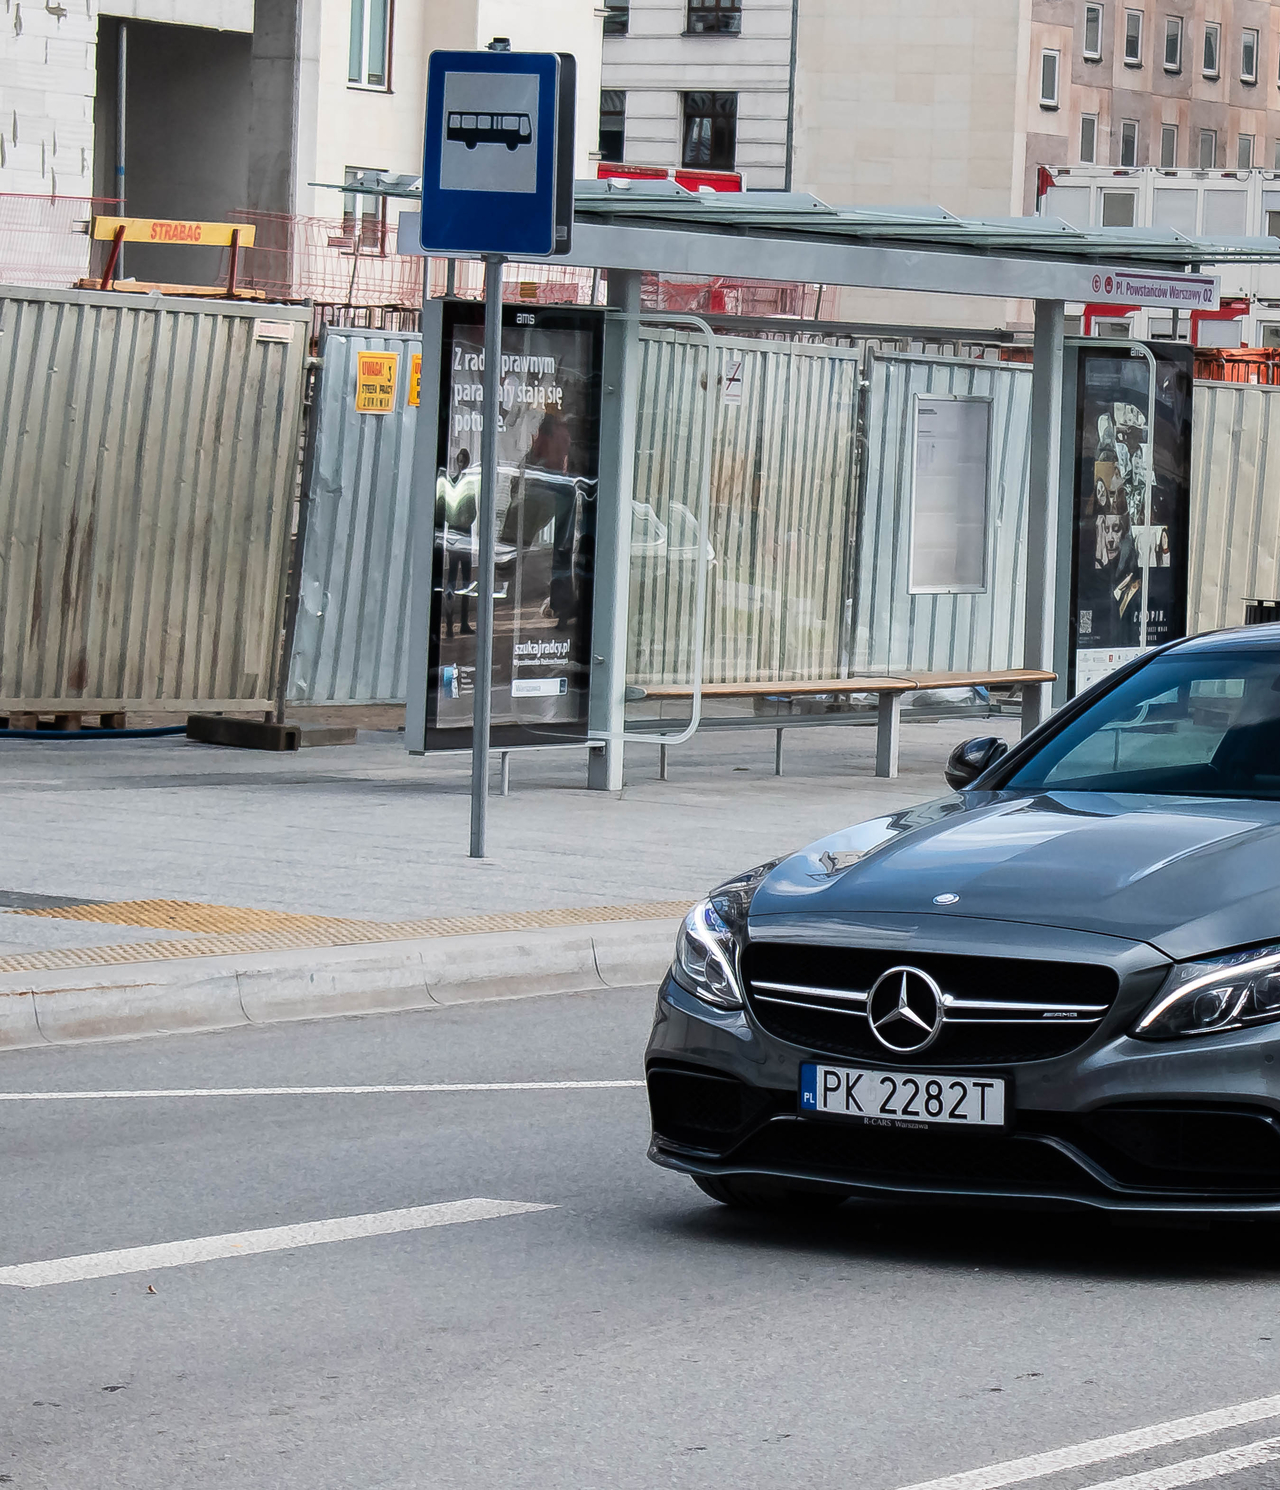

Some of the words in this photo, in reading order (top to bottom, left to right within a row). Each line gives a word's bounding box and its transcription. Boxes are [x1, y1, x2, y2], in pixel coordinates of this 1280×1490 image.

[150, 222, 202, 241] STRABAG
[1115, 281, 1124, 295] Pl.
[1126, 282, 1168, 299] Powstańców
[1169, 286, 1201, 304] Warszawy
[1203, 288, 1213, 302] 02
[516, 313, 535, 324] ams
[454, 347, 462, 370] Z
[464, 348, 485, 370] rad
[501, 355, 555, 378] prawnym
[517, 381, 546, 410] stają
[548, 381, 563, 410] się
[514, 639, 571, 657] szukajradcy.pl
[803, 1092, 815, 1103] PL
[822, 1069, 864, 1112] PK
[879, 1076, 995, 1121] 2282T
[864, 1117, 892, 1127] R-CARS
[895, 1120, 929, 1130] Warszawa
